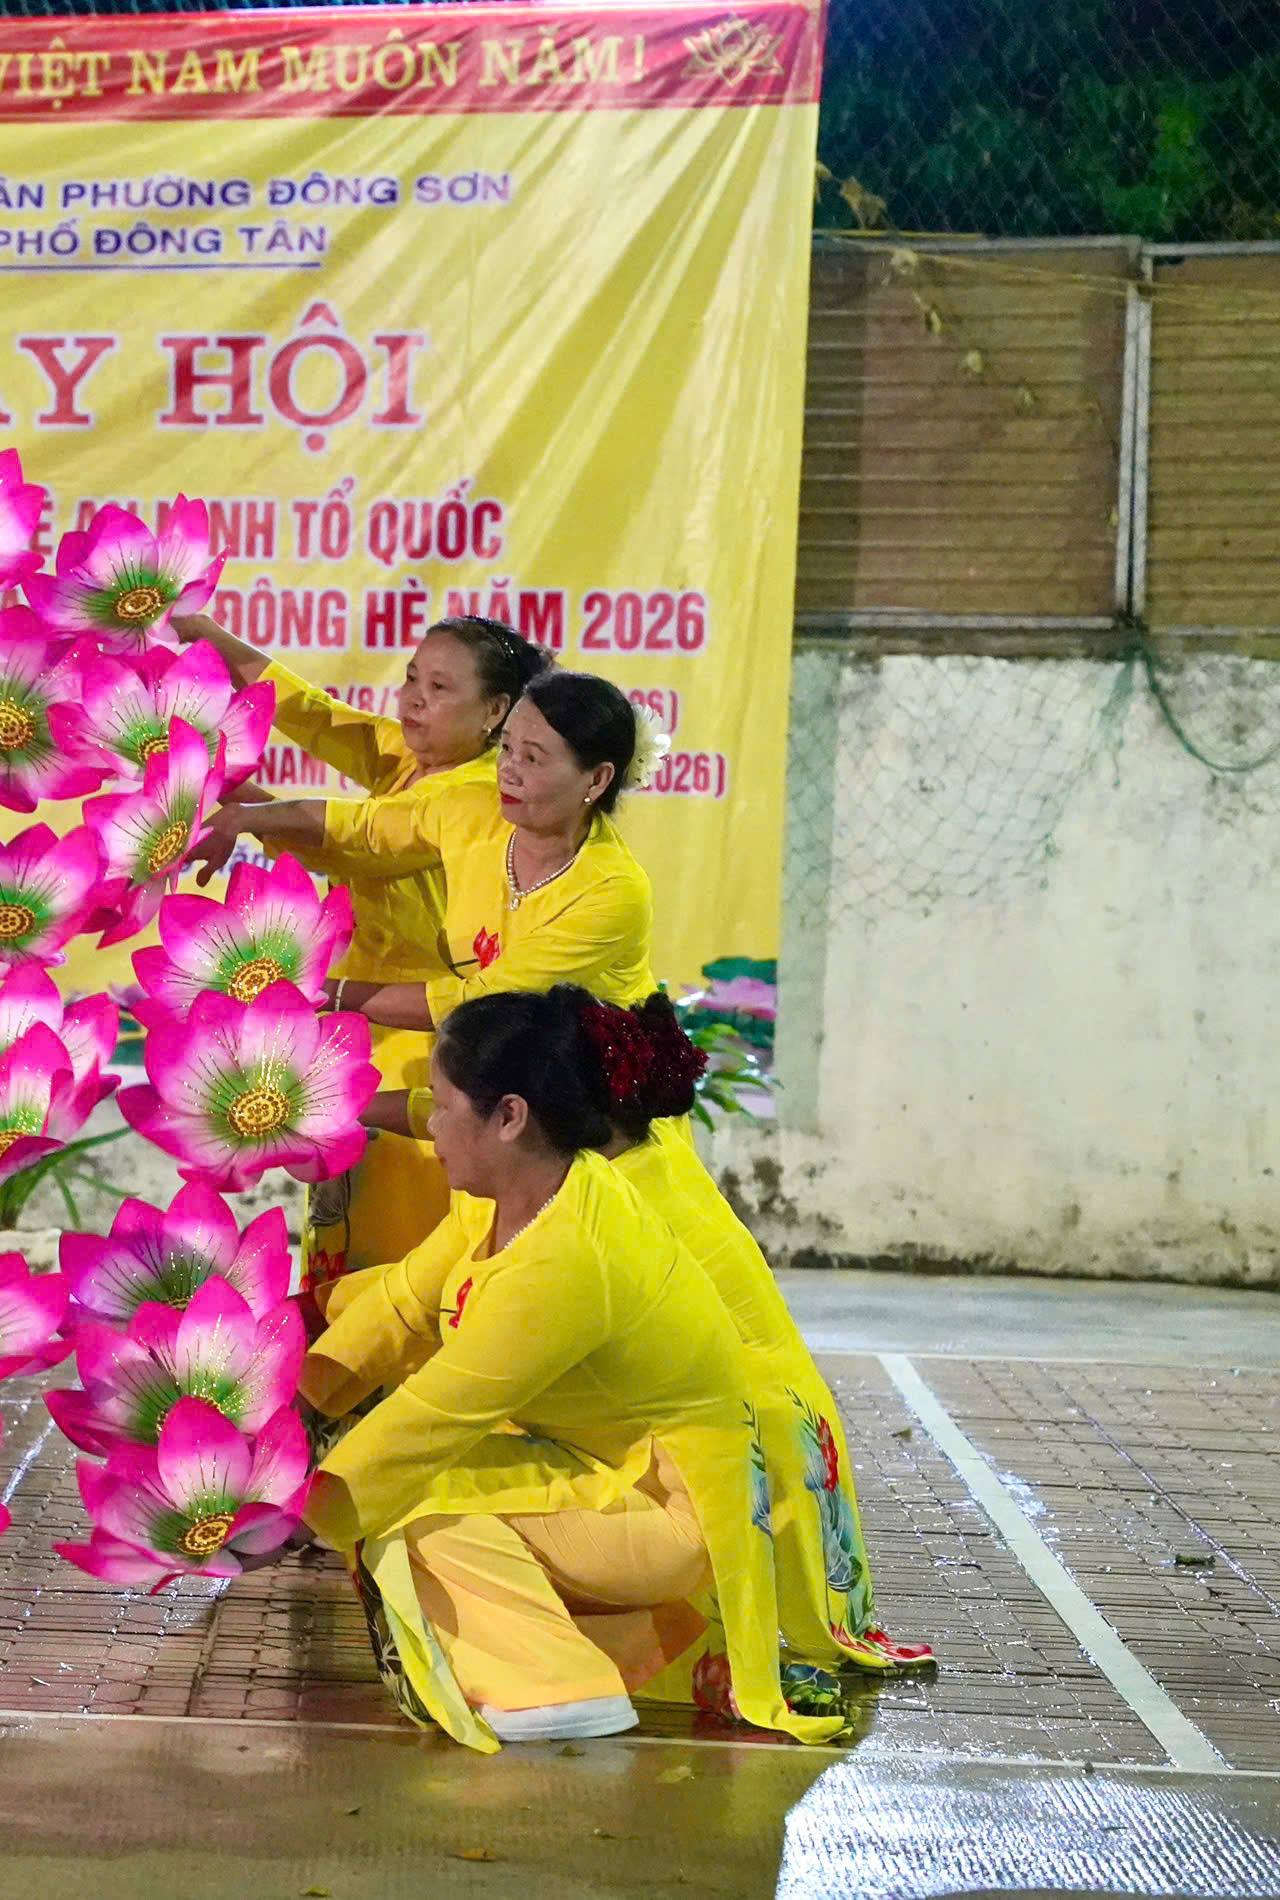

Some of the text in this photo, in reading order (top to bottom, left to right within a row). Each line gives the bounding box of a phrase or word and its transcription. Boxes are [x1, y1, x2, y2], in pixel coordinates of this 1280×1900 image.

[126, 48, 261, 95] NAM
[282, 28, 460, 92] MUÔN
[63, 172, 250, 208] PHƯỜNG
[268, 170, 399, 205] ĐÔNG
[417, 170, 510, 203] SƠN
[94, 220, 222, 255] ĐÔNG
[238, 219, 327, 253] TÂN
[159, 303, 426, 452] HỘI
[291, 475, 354, 560] TỔ
[368, 478, 502, 566] QUỐC
[366, 576, 428, 650] HÈ
[582, 590, 705, 652] 2026
[254, 746, 327, 787] NAM
